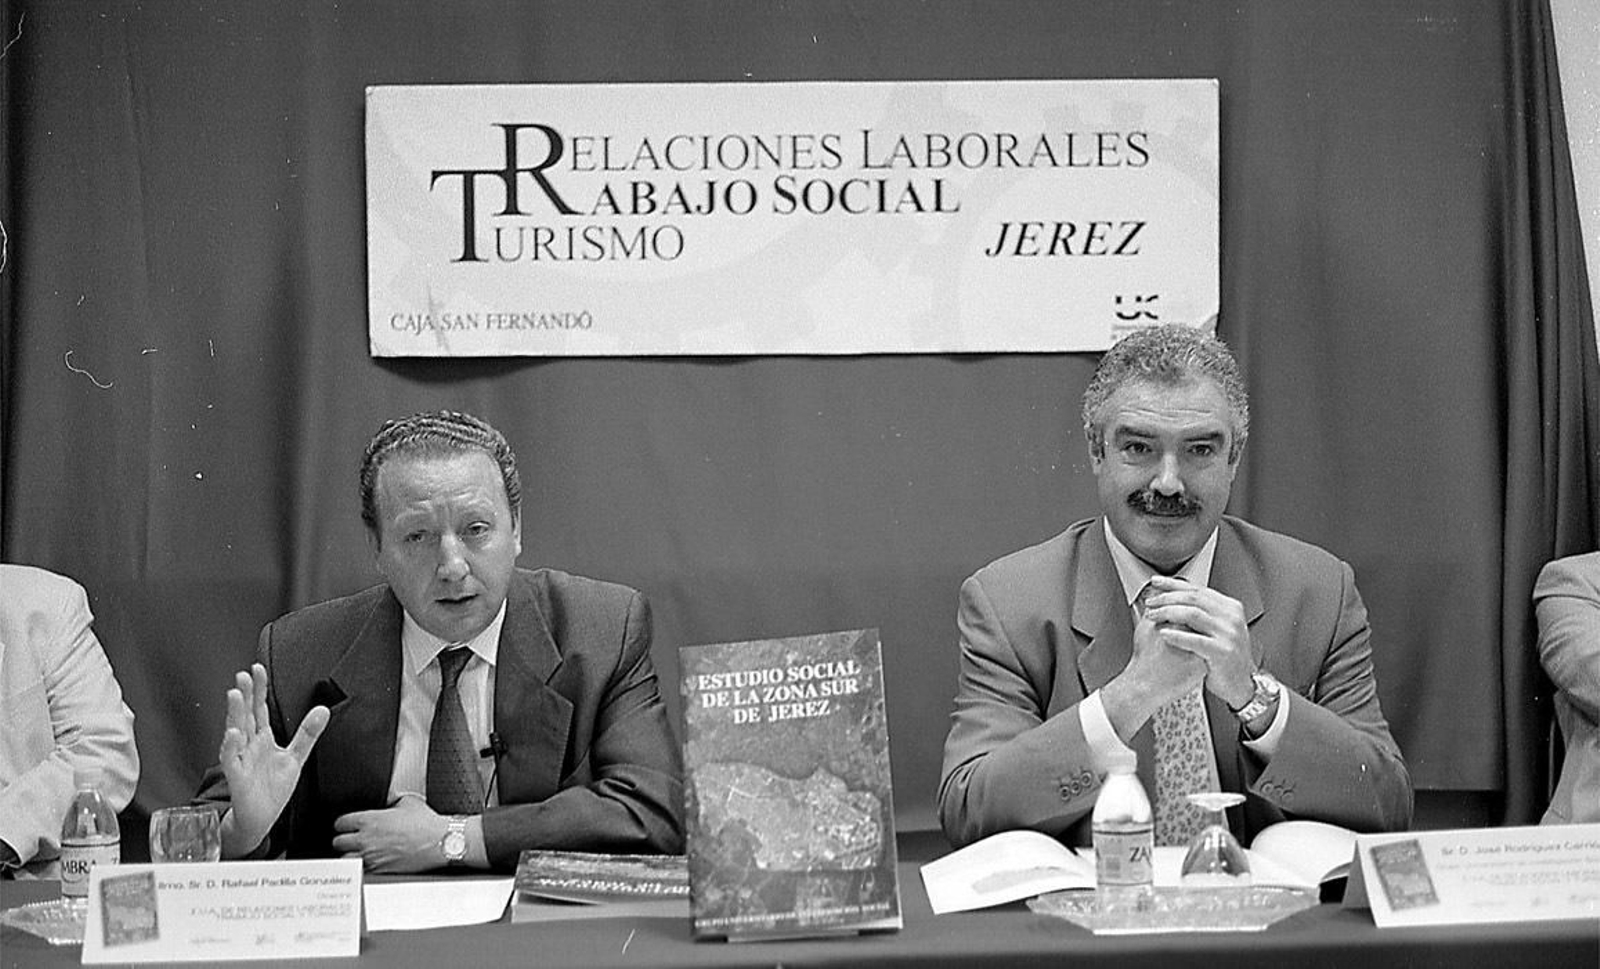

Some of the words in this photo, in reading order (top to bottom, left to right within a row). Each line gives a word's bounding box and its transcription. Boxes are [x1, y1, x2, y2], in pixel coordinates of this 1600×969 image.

[491, 123, 843, 216] RELACIONES
[862, 129, 1150, 169] LABORALES
[772, 174, 961, 215] SOCIAL
[430, 170, 685, 262] TURISMO
[985, 221, 1147, 257] JEREZ
[391, 313, 434, 336] CAJA
[440, 313, 480, 331] SAN
[698, 668, 784, 690] ESTUDIO
[787, 660, 861, 682] SOCIAL
[701, 691, 730, 708] DE
[734, 690, 760, 705] LA
[763, 683, 818, 703] ZONA
[820, 679, 859, 697] SUR
[734, 707, 761, 724] DE
[768, 700, 831, 722] JEREZ
[221, 878, 258, 888] Rafael
[261, 877, 297, 887] Padilla
